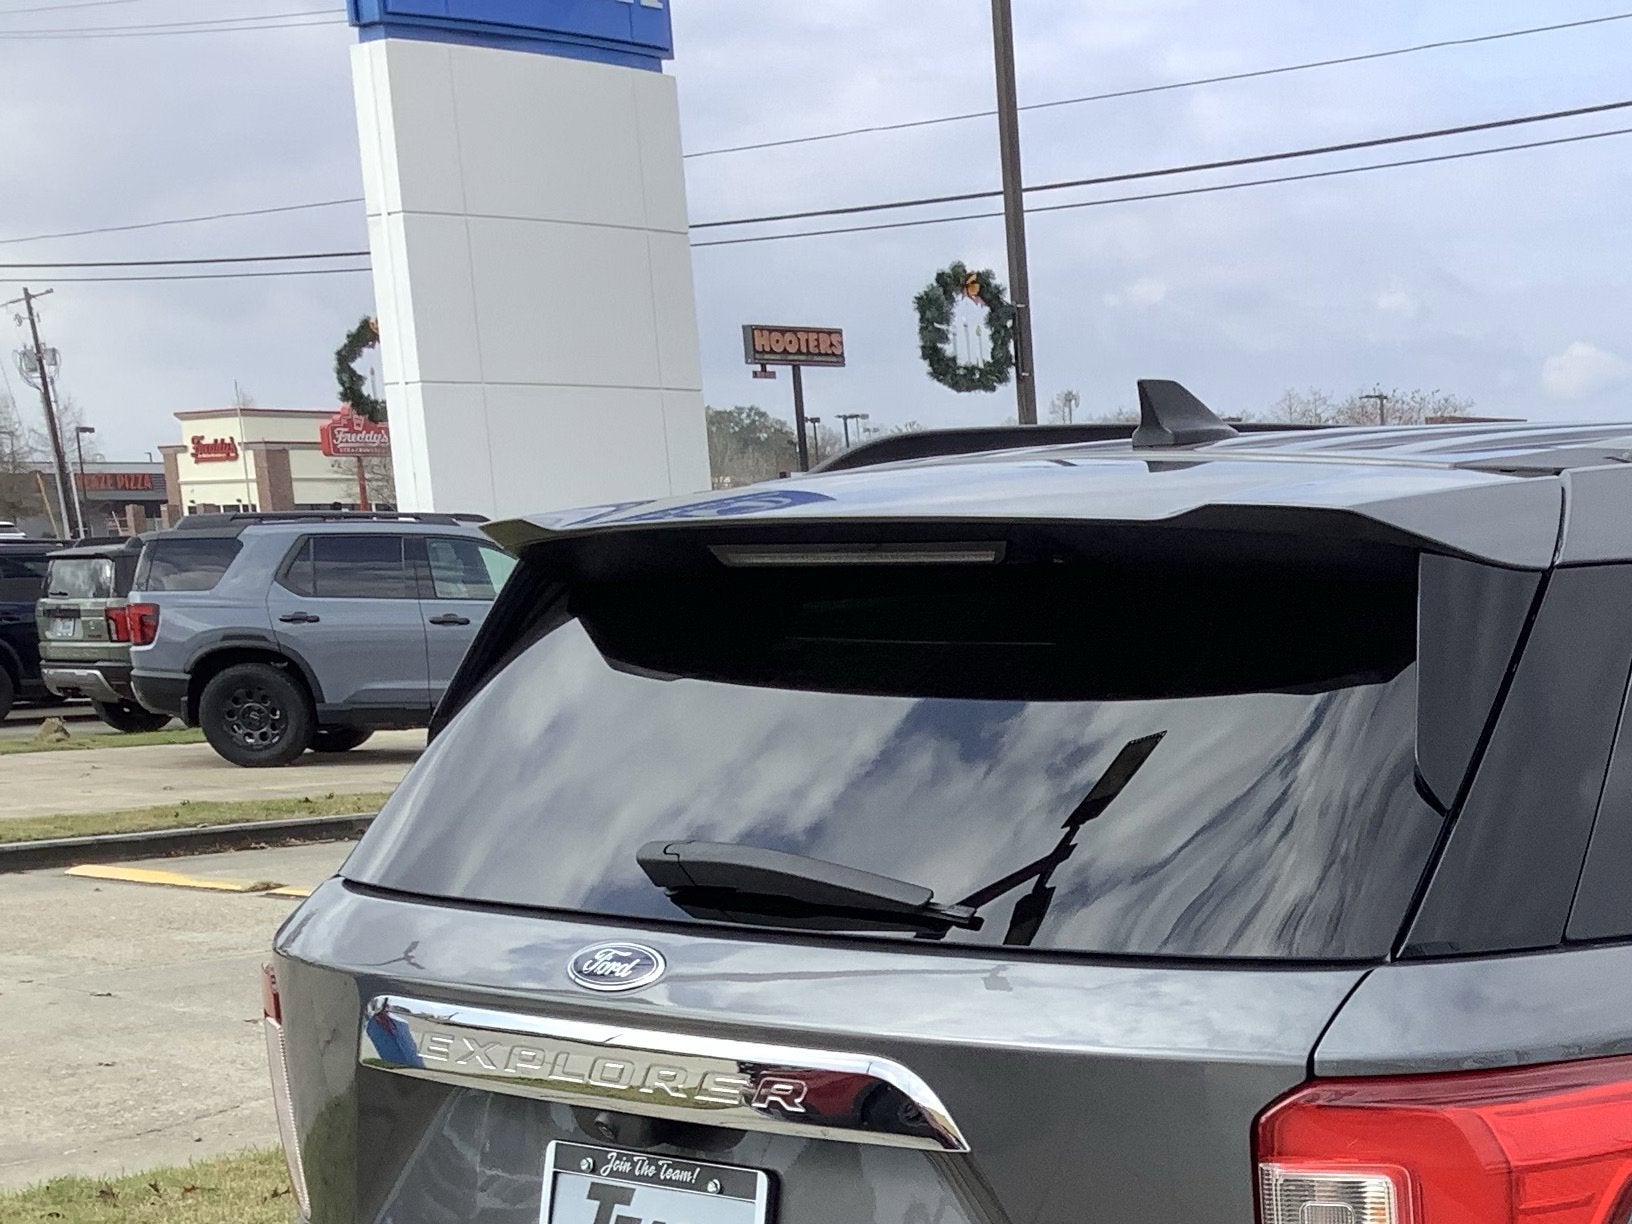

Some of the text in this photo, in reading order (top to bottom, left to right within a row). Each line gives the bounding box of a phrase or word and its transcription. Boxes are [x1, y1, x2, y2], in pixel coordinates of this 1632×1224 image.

[753, 329, 843, 355] HOOTERS
[333, 427, 388, 448] Freddy's
[582, 948, 640, 978] Ford
[416, 1030, 810, 1114] EXPLORER
[600, 1151, 700, 1184] Join The Team!
